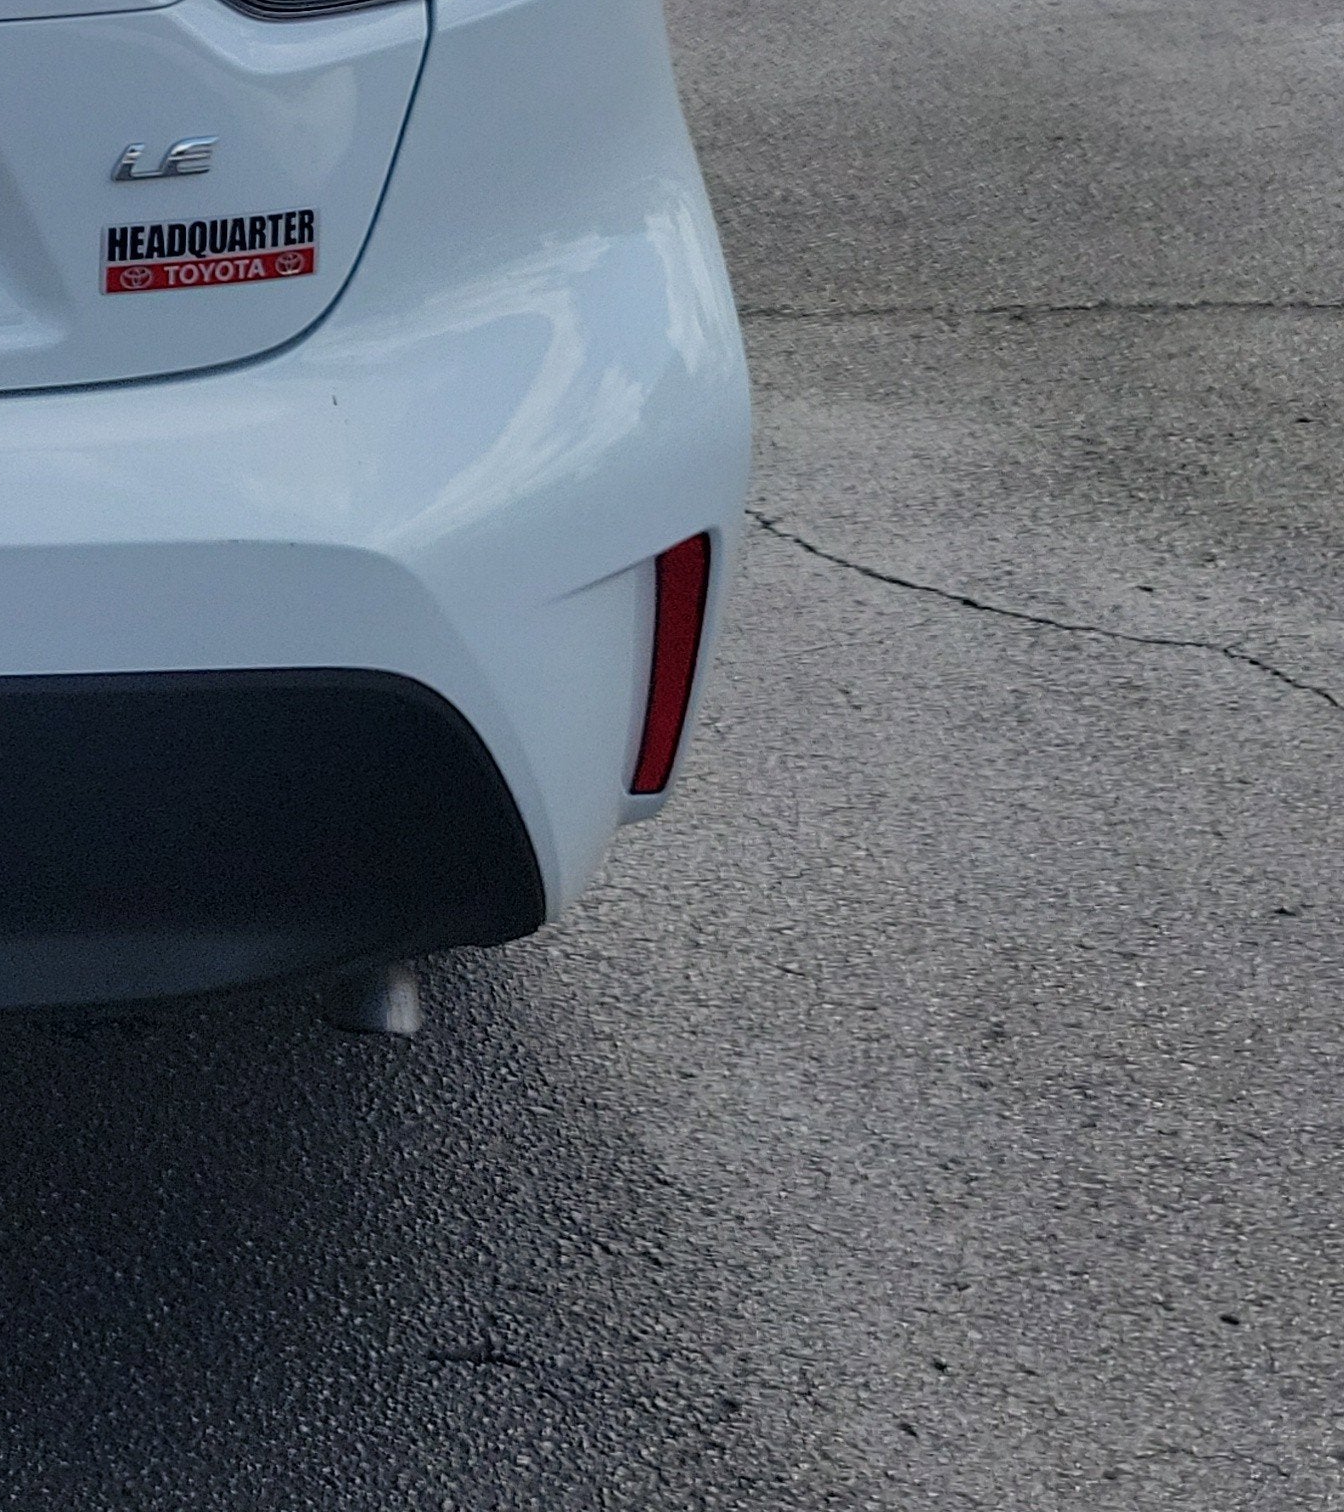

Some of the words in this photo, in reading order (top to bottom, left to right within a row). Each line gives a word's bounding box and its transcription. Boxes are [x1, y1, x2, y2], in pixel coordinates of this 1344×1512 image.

[112, 135, 219, 182] LE
[107, 209, 315, 262] HEADQUARTER
[164, 258, 267, 285] TOYOTA
